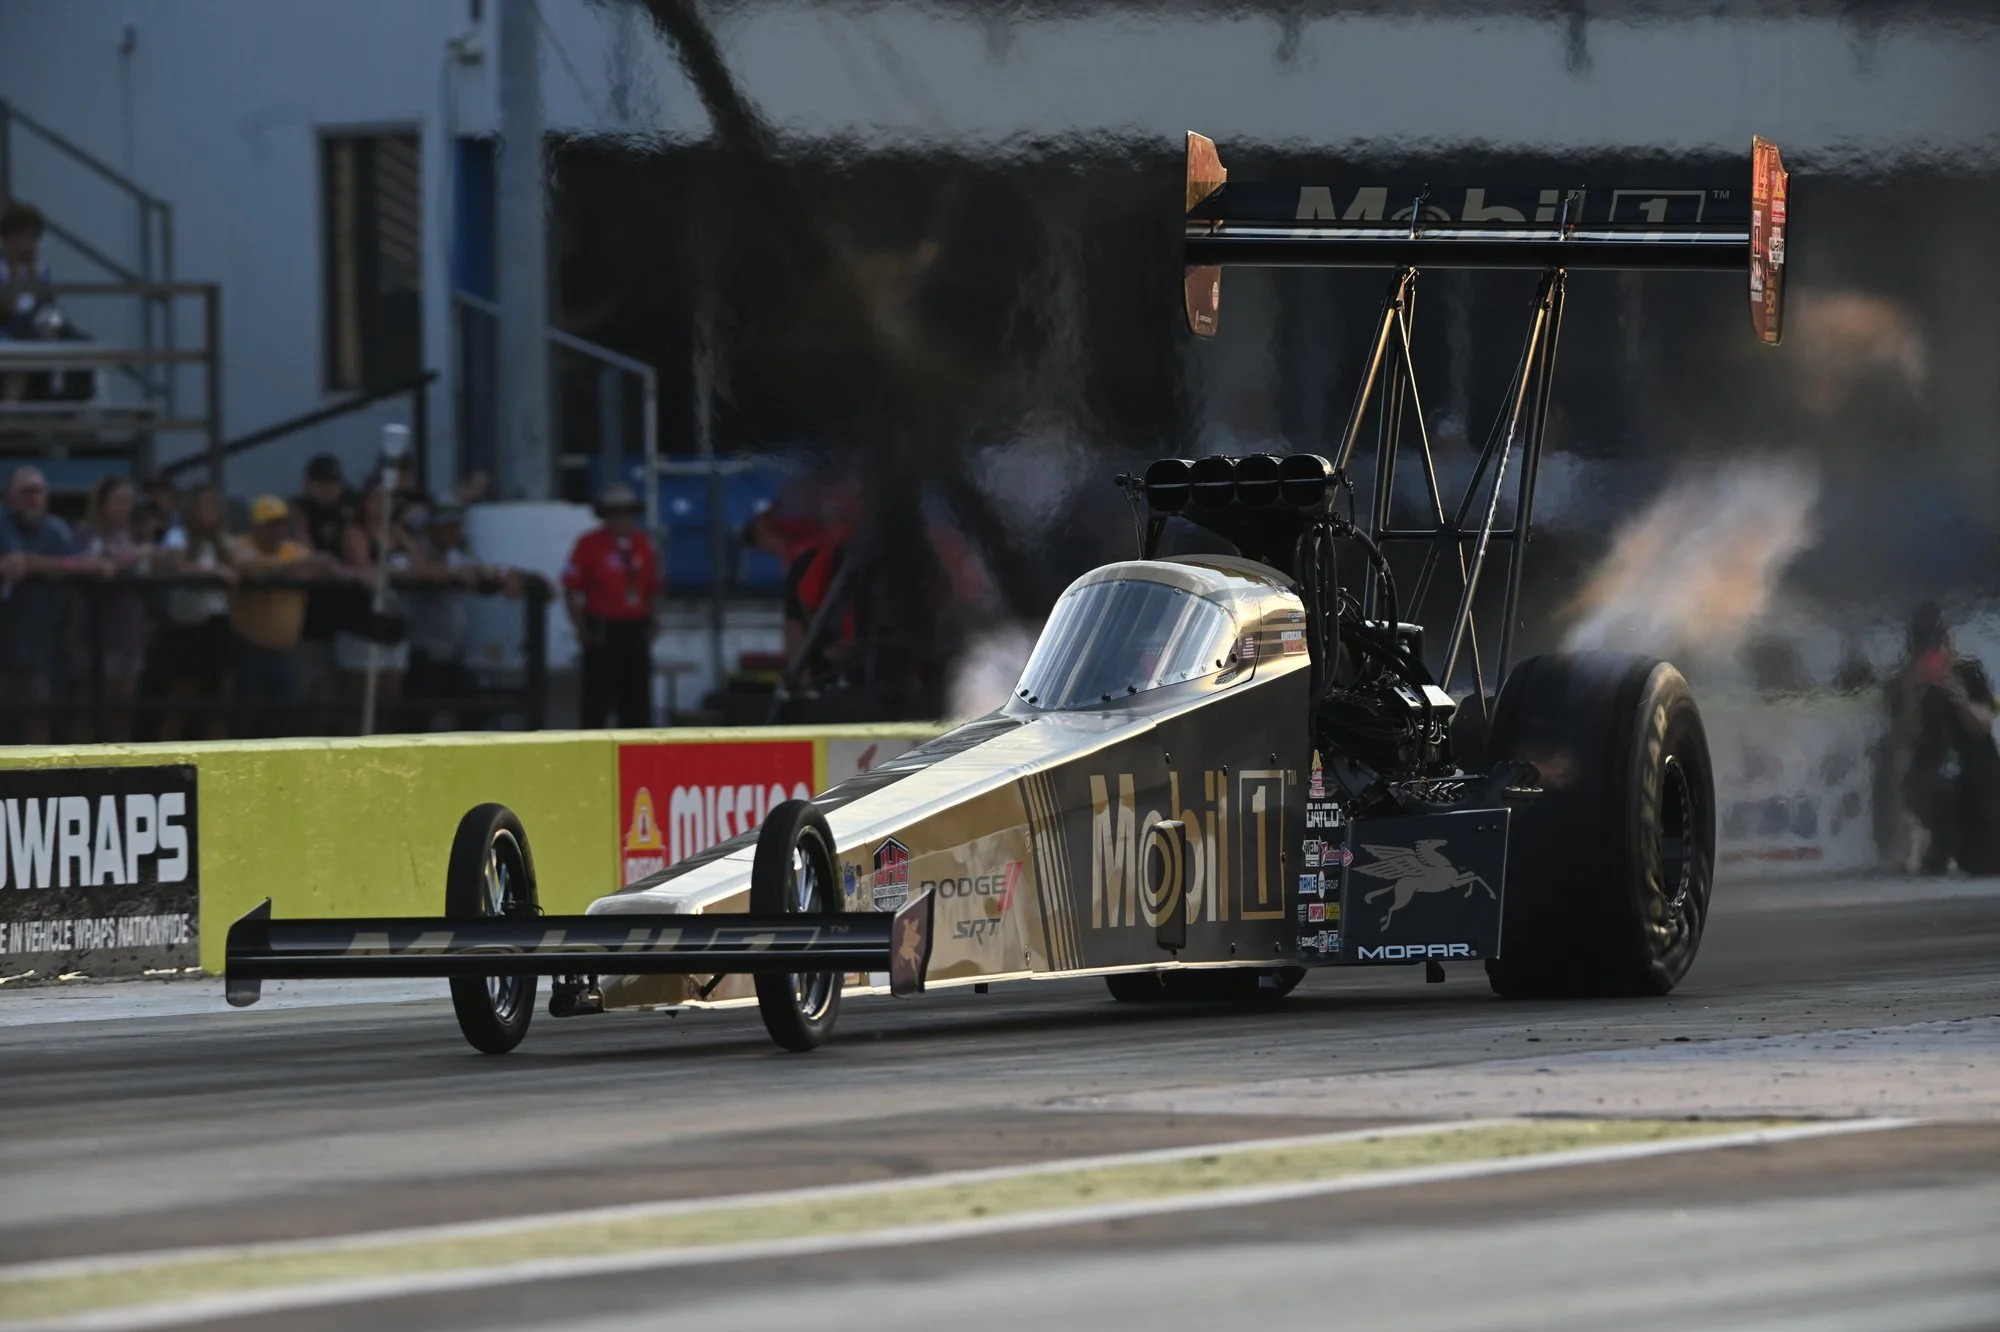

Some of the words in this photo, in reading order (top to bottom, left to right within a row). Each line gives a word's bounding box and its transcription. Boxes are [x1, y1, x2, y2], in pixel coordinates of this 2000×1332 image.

[0, 792, 188, 889] WRAPS
[670, 782, 812, 867] MISS
[1090, 769, 1228, 928] Mobil
[920, 875, 1006, 898] DODGE
[9, 922, 22, 953] IN
[25, 919, 71, 952] VEHICLE
[74, 917, 116, 950] WRAPS
[117, 912, 189, 947] NATIONWIDE
[953, 918, 1000, 945] SRT
